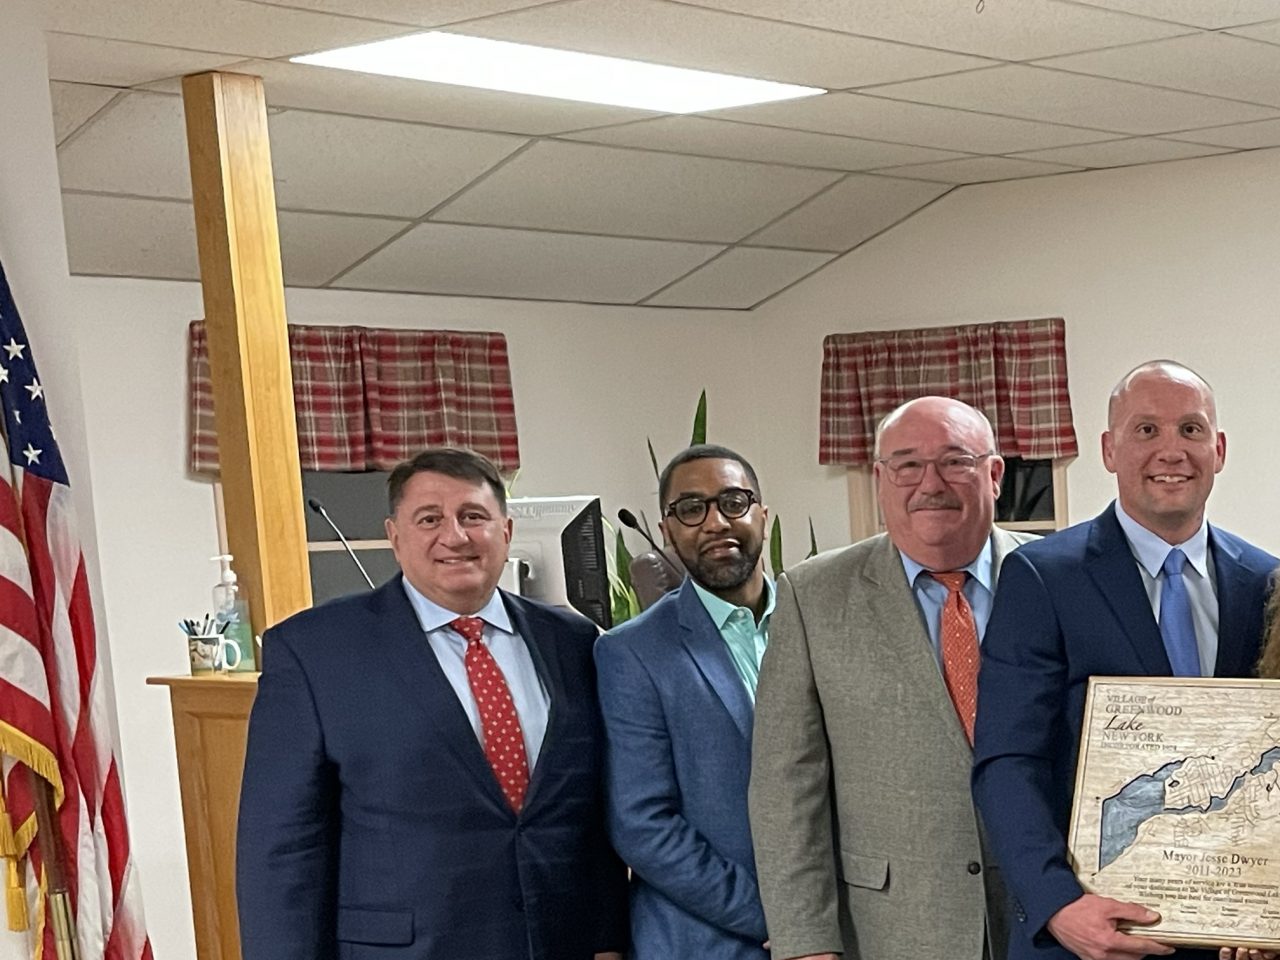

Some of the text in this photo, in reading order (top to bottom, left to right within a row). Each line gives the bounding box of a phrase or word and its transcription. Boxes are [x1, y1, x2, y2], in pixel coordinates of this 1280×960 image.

[1106, 695, 1147, 704] VILLAGE
[1105, 703, 1183, 716] GREENWOOD
[1104, 708, 1144, 731] Lake
[1102, 731, 1164, 743] NEW YORK
[1162, 849, 1269, 868] Mayor Jesse Dwyer
[1185, 864, 1242, 878] 2011-2023
